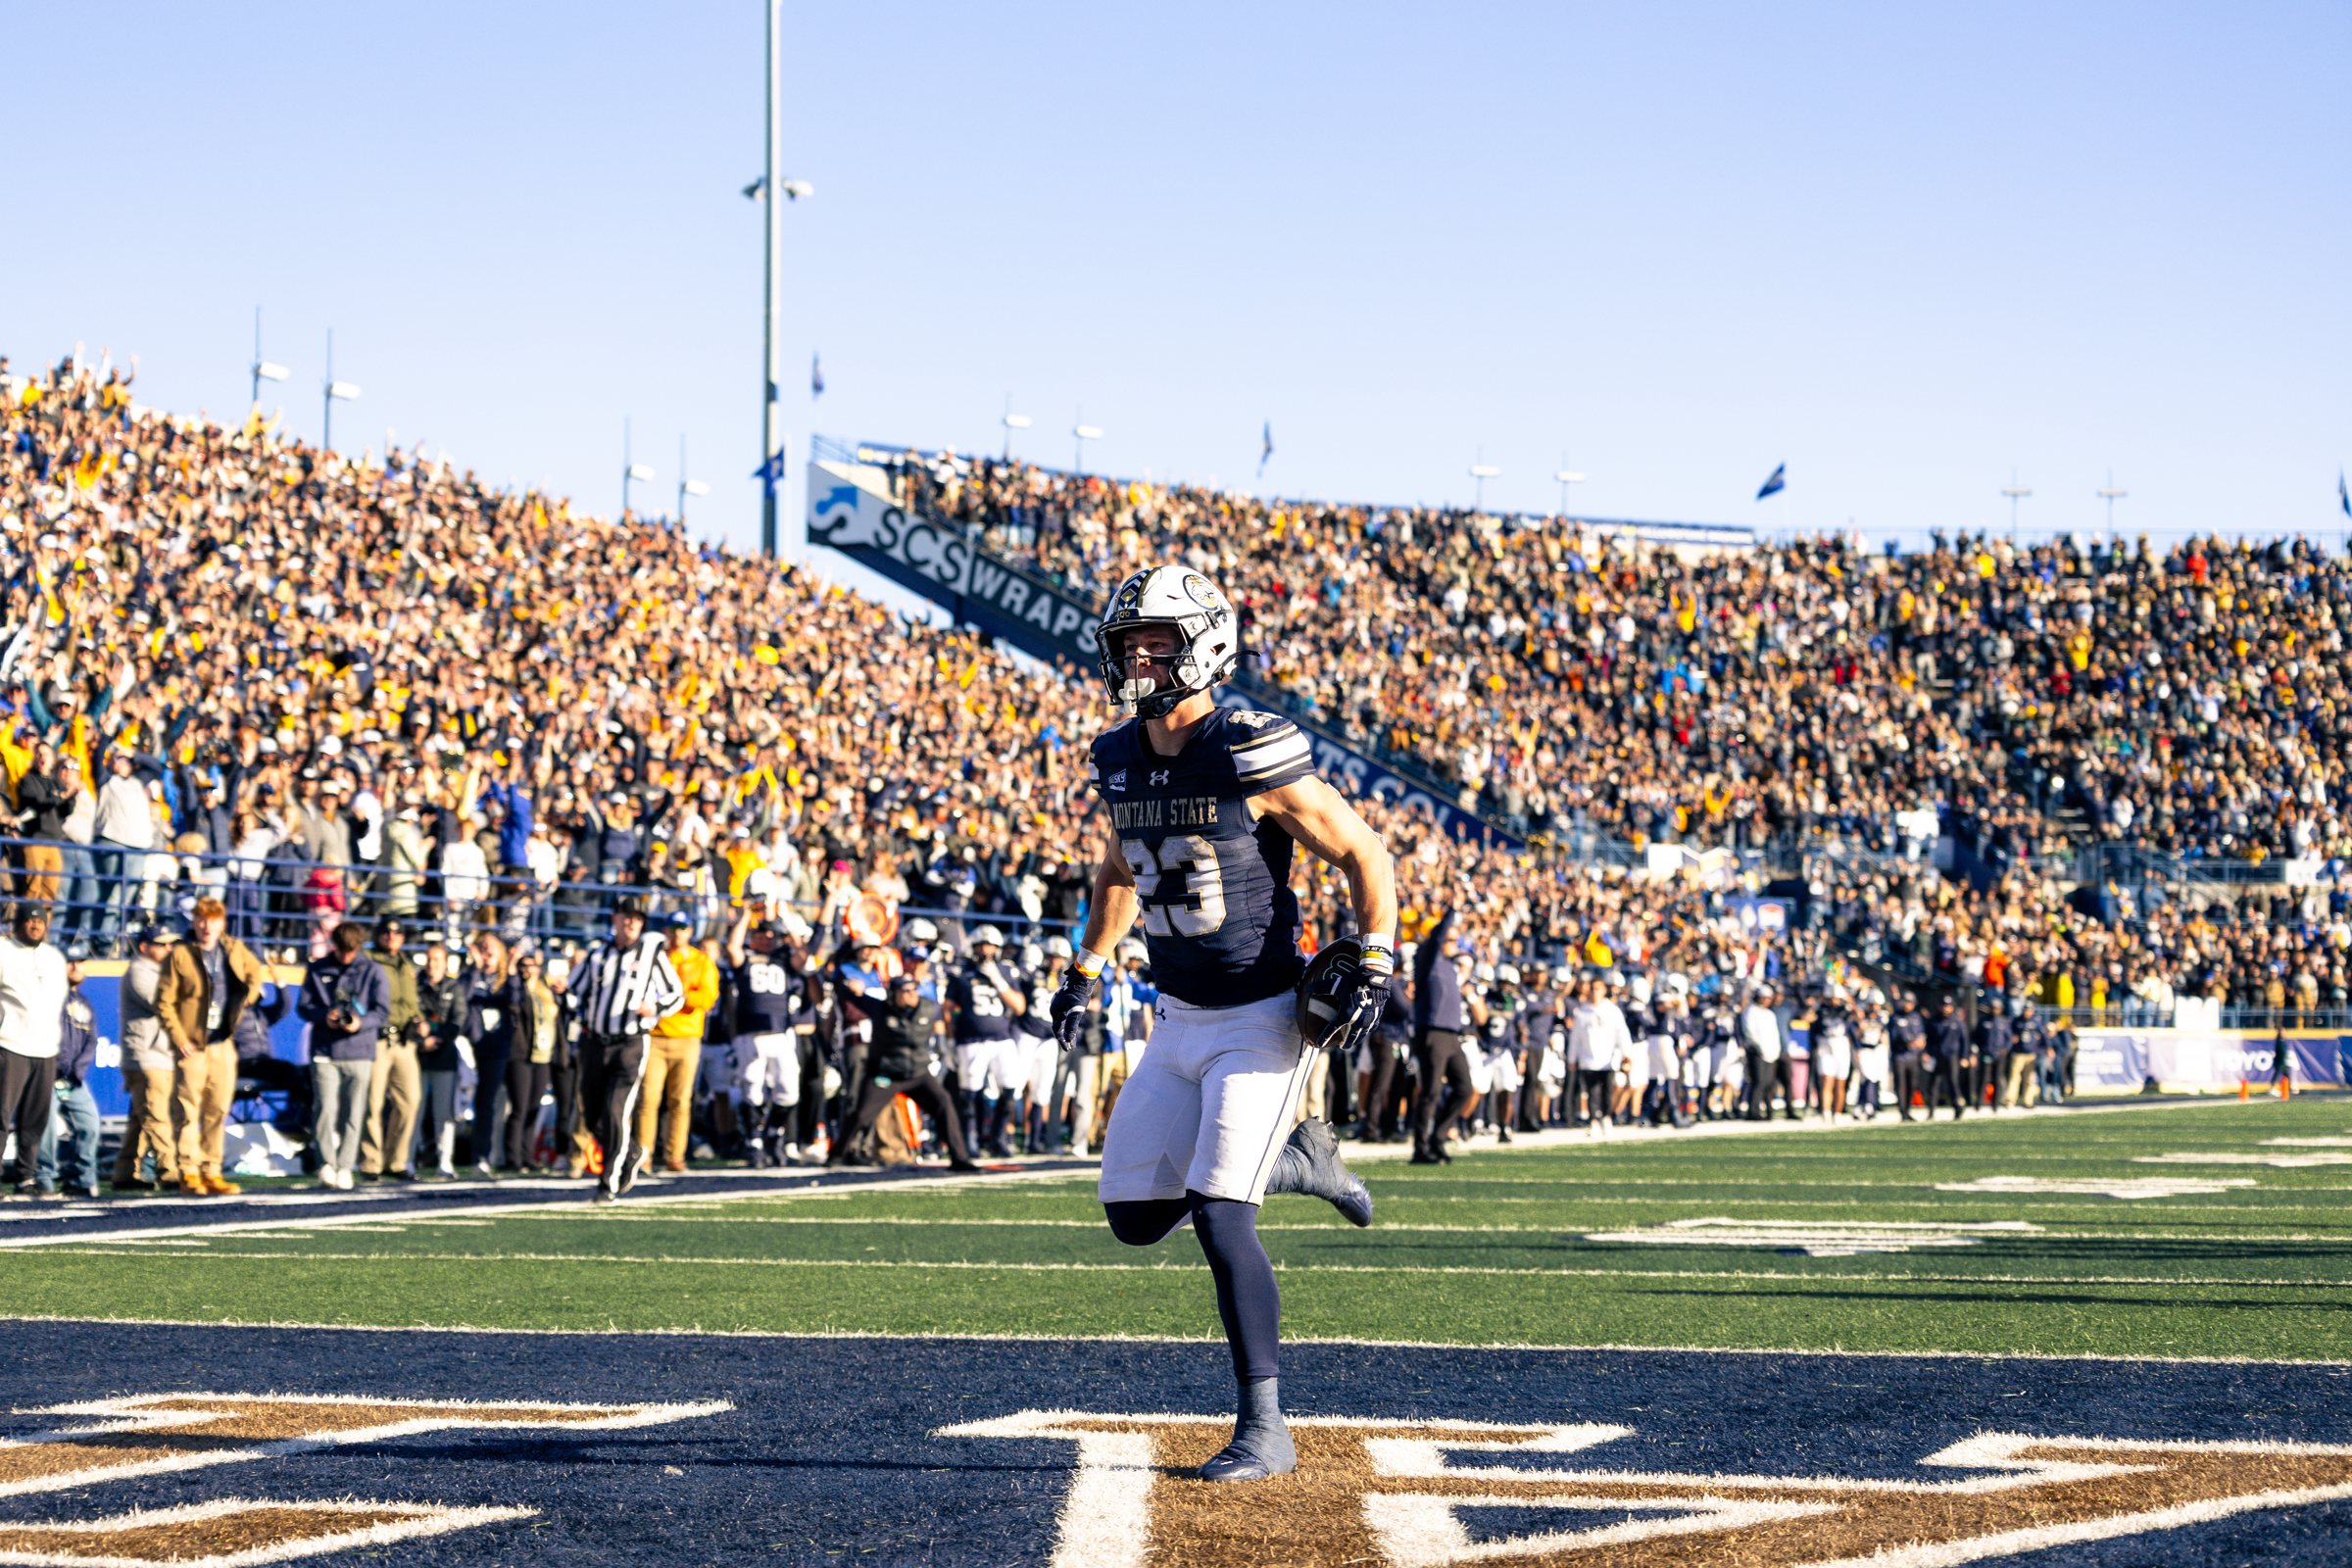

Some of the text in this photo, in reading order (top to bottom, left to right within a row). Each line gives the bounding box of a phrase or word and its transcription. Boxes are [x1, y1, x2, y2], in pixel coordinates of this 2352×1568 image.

[873, 508, 1100, 654] SCS WRAPS
[1113, 797, 1218, 829] MONTANA STATE
[1121, 835, 1227, 938] 23
[2217, 1050, 2301, 1071] TOYOA
